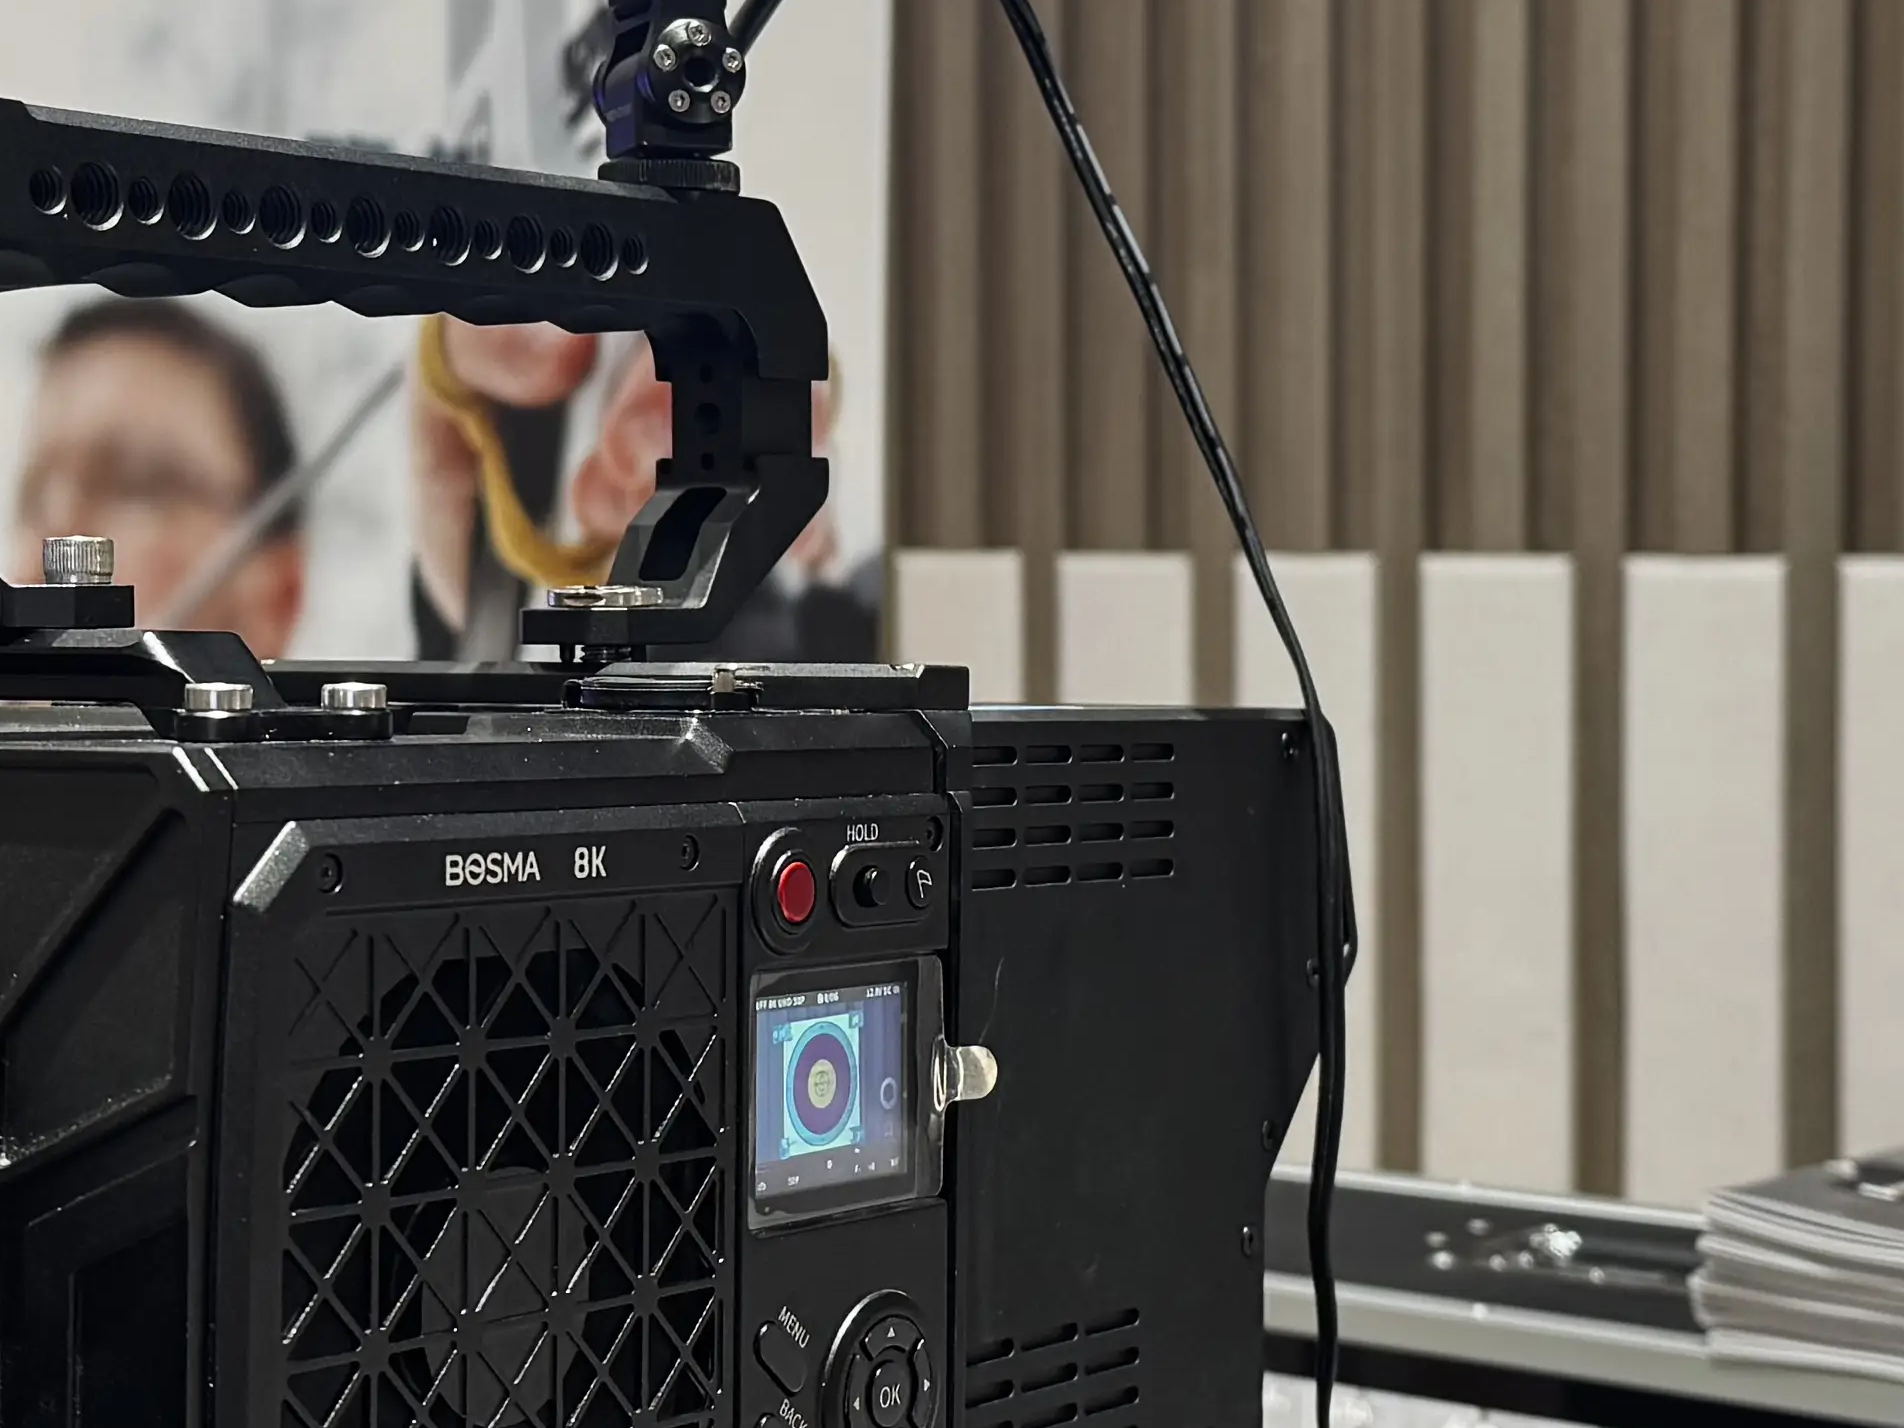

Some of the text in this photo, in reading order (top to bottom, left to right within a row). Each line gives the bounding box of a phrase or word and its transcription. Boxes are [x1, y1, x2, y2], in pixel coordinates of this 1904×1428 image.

[846, 823, 879, 842] HOLD
[445, 845, 608, 887] BOSMA 8K
[777, 1305, 811, 1349] MENU
[879, 1383, 901, 1409] OK
